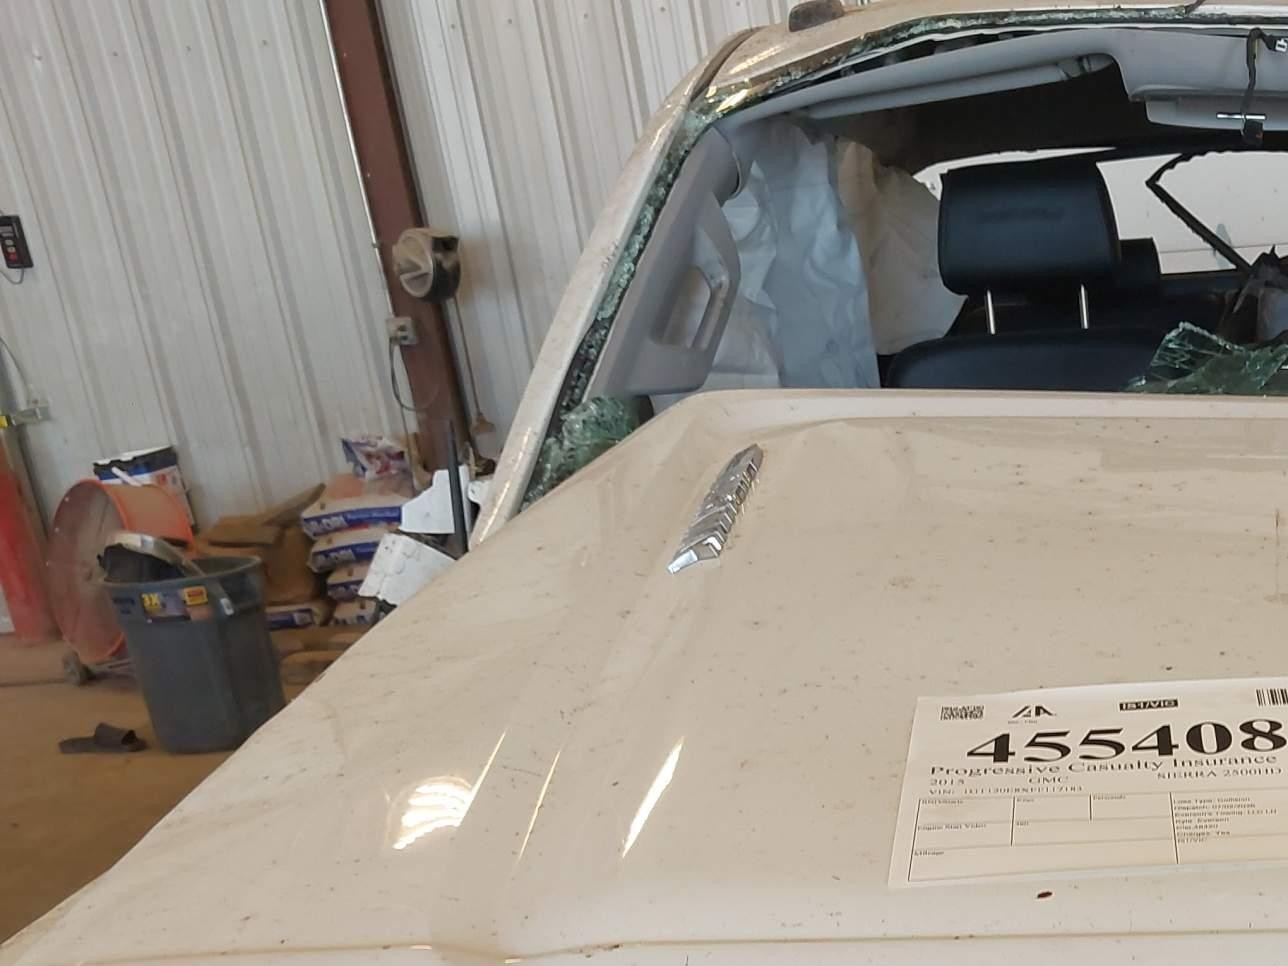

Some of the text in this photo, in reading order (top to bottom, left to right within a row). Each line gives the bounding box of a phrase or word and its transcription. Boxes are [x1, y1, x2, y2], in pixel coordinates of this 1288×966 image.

[930, 755, 1278, 778] Progressive Casualty Insurance
[1028, 776, 1069, 785] GMC
[1157, 770, 1217, 780] SIERRA
